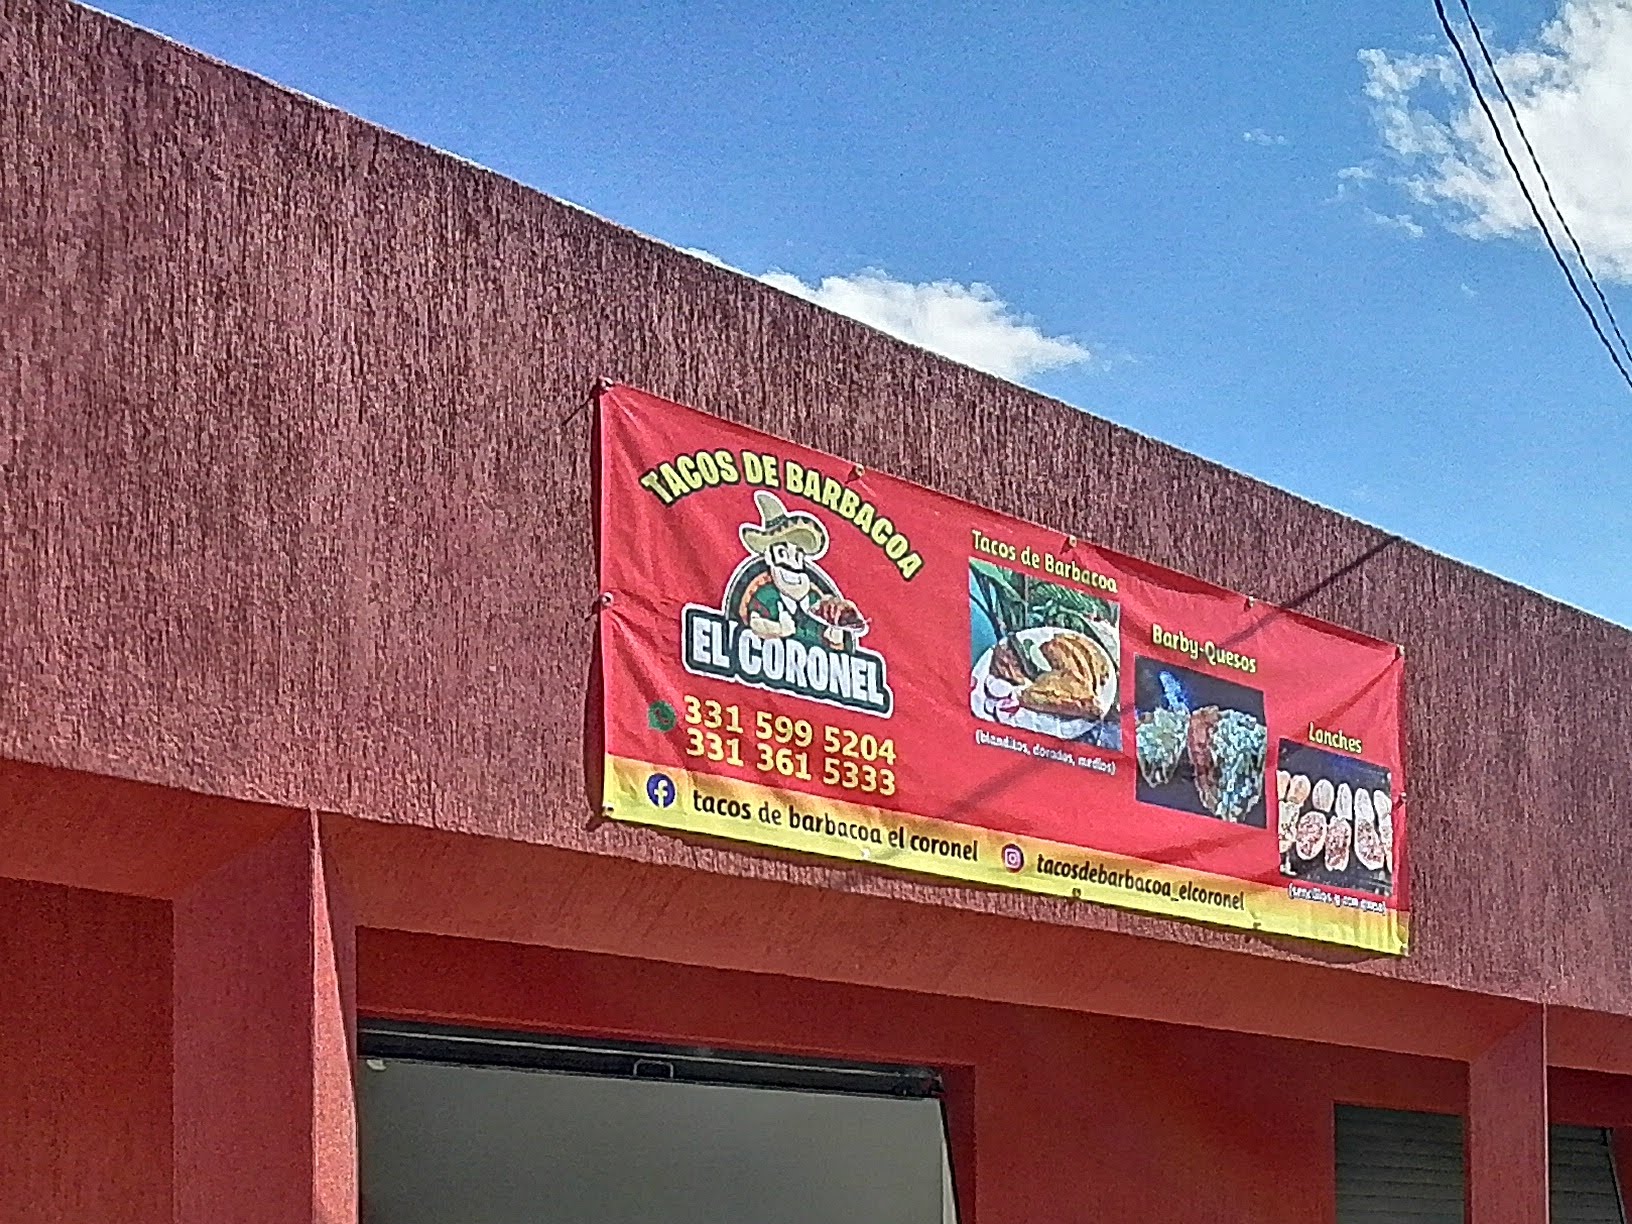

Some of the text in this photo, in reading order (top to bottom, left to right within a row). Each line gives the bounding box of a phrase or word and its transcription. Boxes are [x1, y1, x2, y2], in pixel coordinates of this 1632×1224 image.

[641, 449, 925, 581] TACOS DE BARBACOA
[972, 530, 1117, 594] Tacos de Barbacoa
[692, 617, 885, 705] EL CORONEL
[1152, 625, 1256, 673] Barby-Quesos
[684, 696, 896, 764] 331 599 5204
[686, 728, 896, 795] 331 361 5333
[1308, 723, 1362, 754] Lonches
[693, 790, 979, 862] tacos de barbacoa el coronel
[1036, 853, 1245, 911] tacosdebarbacoa_elcoronel
